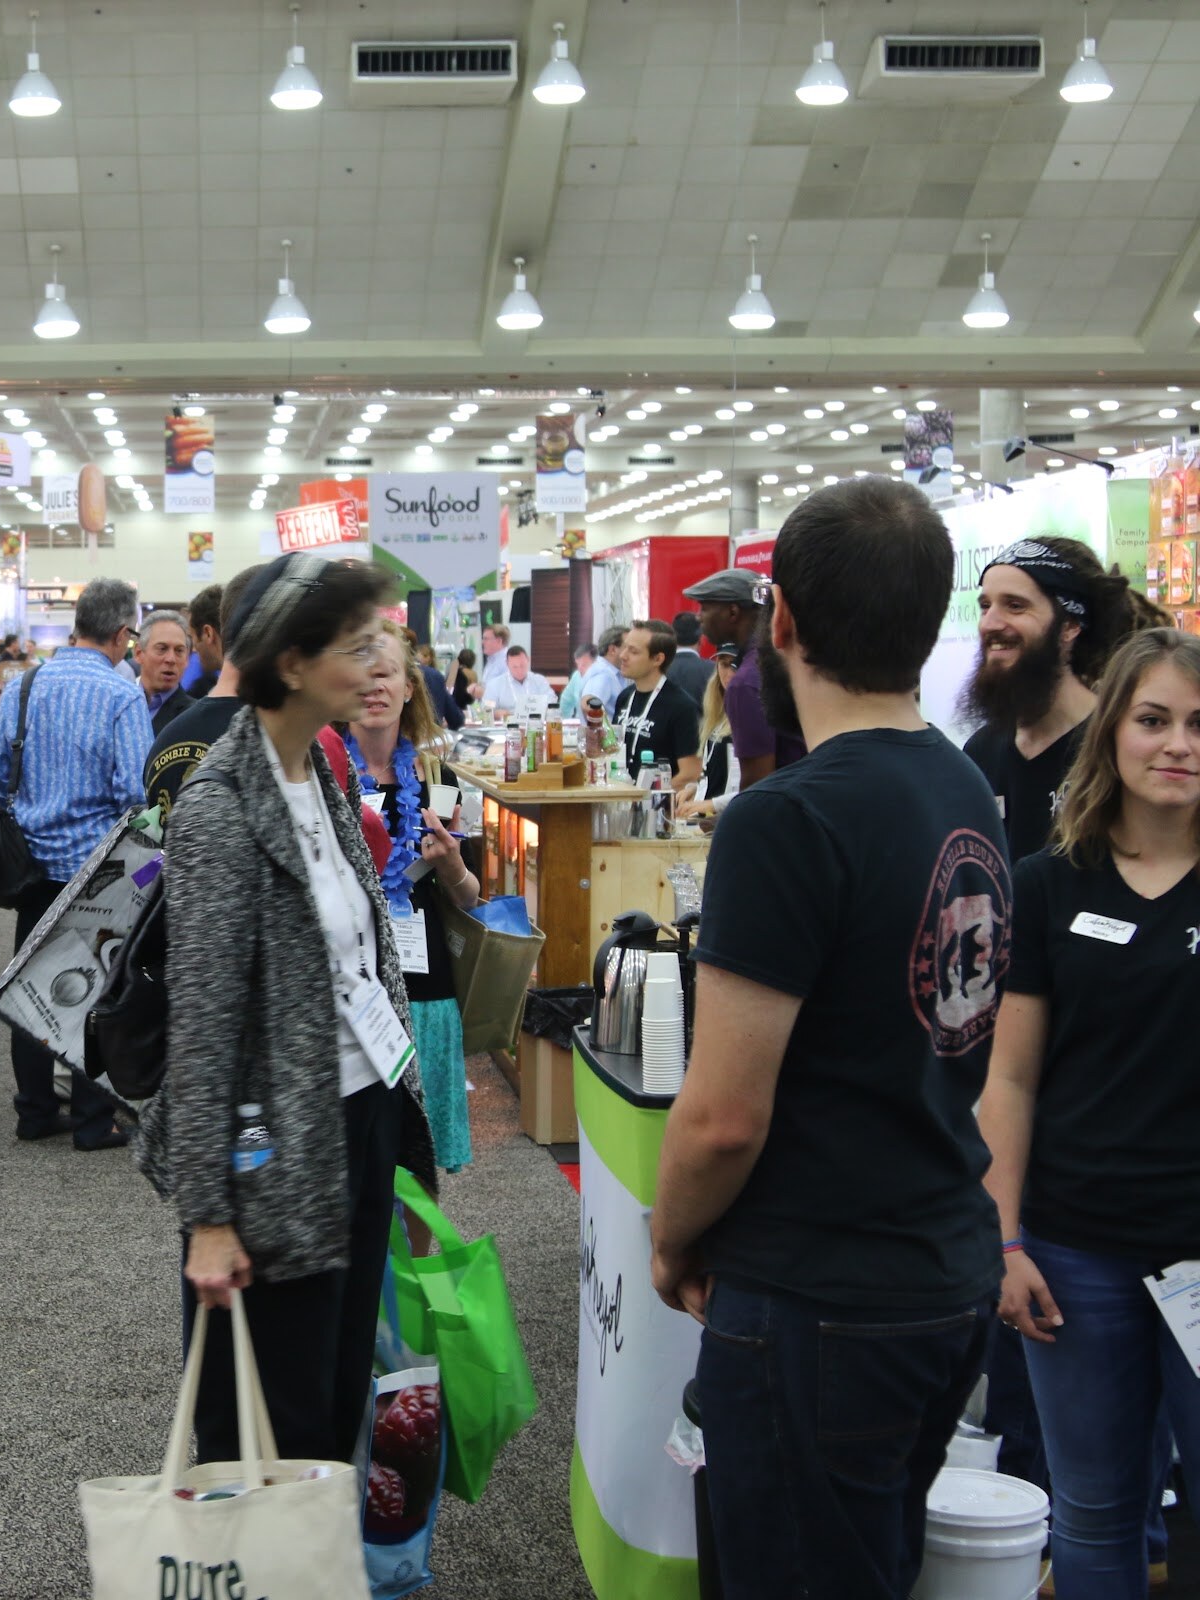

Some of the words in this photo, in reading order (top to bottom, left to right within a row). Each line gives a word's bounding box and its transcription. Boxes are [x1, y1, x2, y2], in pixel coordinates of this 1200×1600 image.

[168, 495, 212, 507] 700/800
[384, 486, 482, 528] Sunfood
[540, 495, 582, 506] 900/1000
[277, 508, 341, 550] PERFECT
[341, 500, 360, 538] Bar
[1118, 528, 1146, 539] Family
[154, 747, 191, 771] ZOMBIE
[194, 748, 208, 760] DE
[967, 840, 1000, 875] HOUND
[78, 904, 114, 916] PARTY?
[157, 1555, 247, 1600] pure
